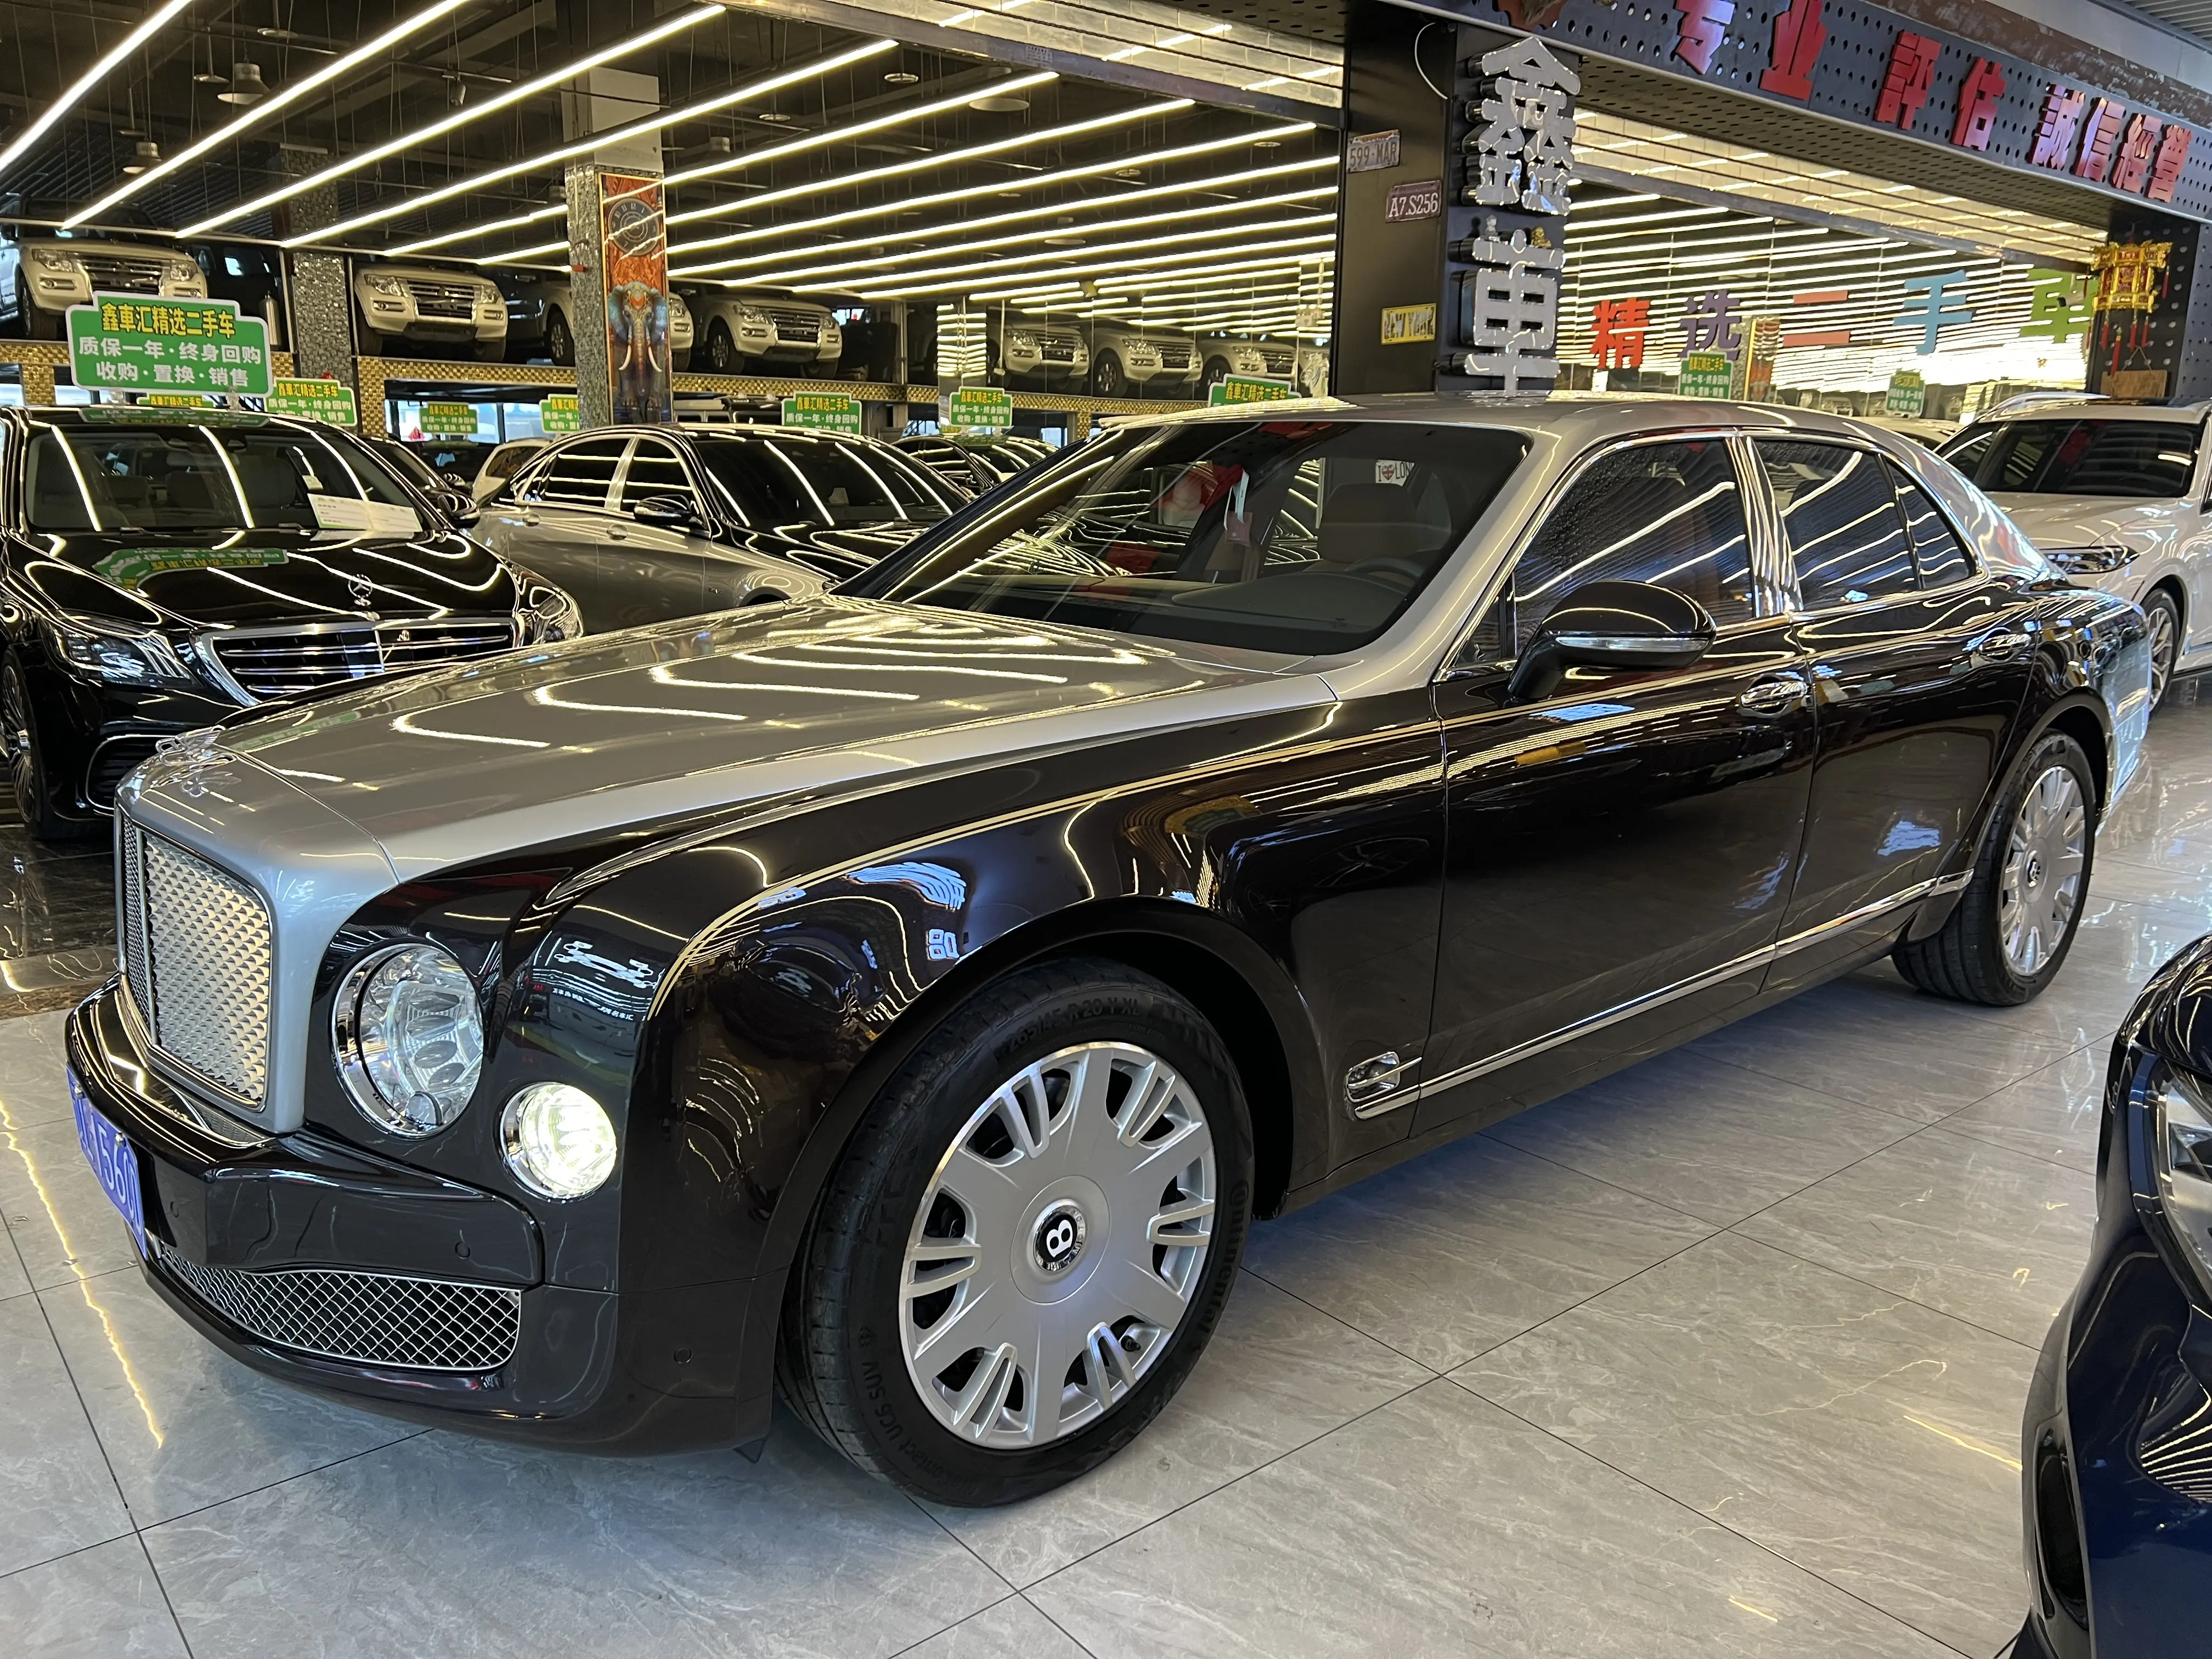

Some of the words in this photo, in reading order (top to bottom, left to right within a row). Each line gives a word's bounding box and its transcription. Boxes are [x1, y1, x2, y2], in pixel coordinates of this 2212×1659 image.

[1388, 192, 1438, 218] A7.S256
[101, 302, 235, 338] 鑫車汇精选二手车
[78, 336, 261, 365] 质保一年·终身回购
[96, 361, 249, 387] 收购·置换·销售
[1378, 465, 1382, 482] I
[1046, 1219, 1073, 1259] B
[861, 1361, 886, 1401] SUV
